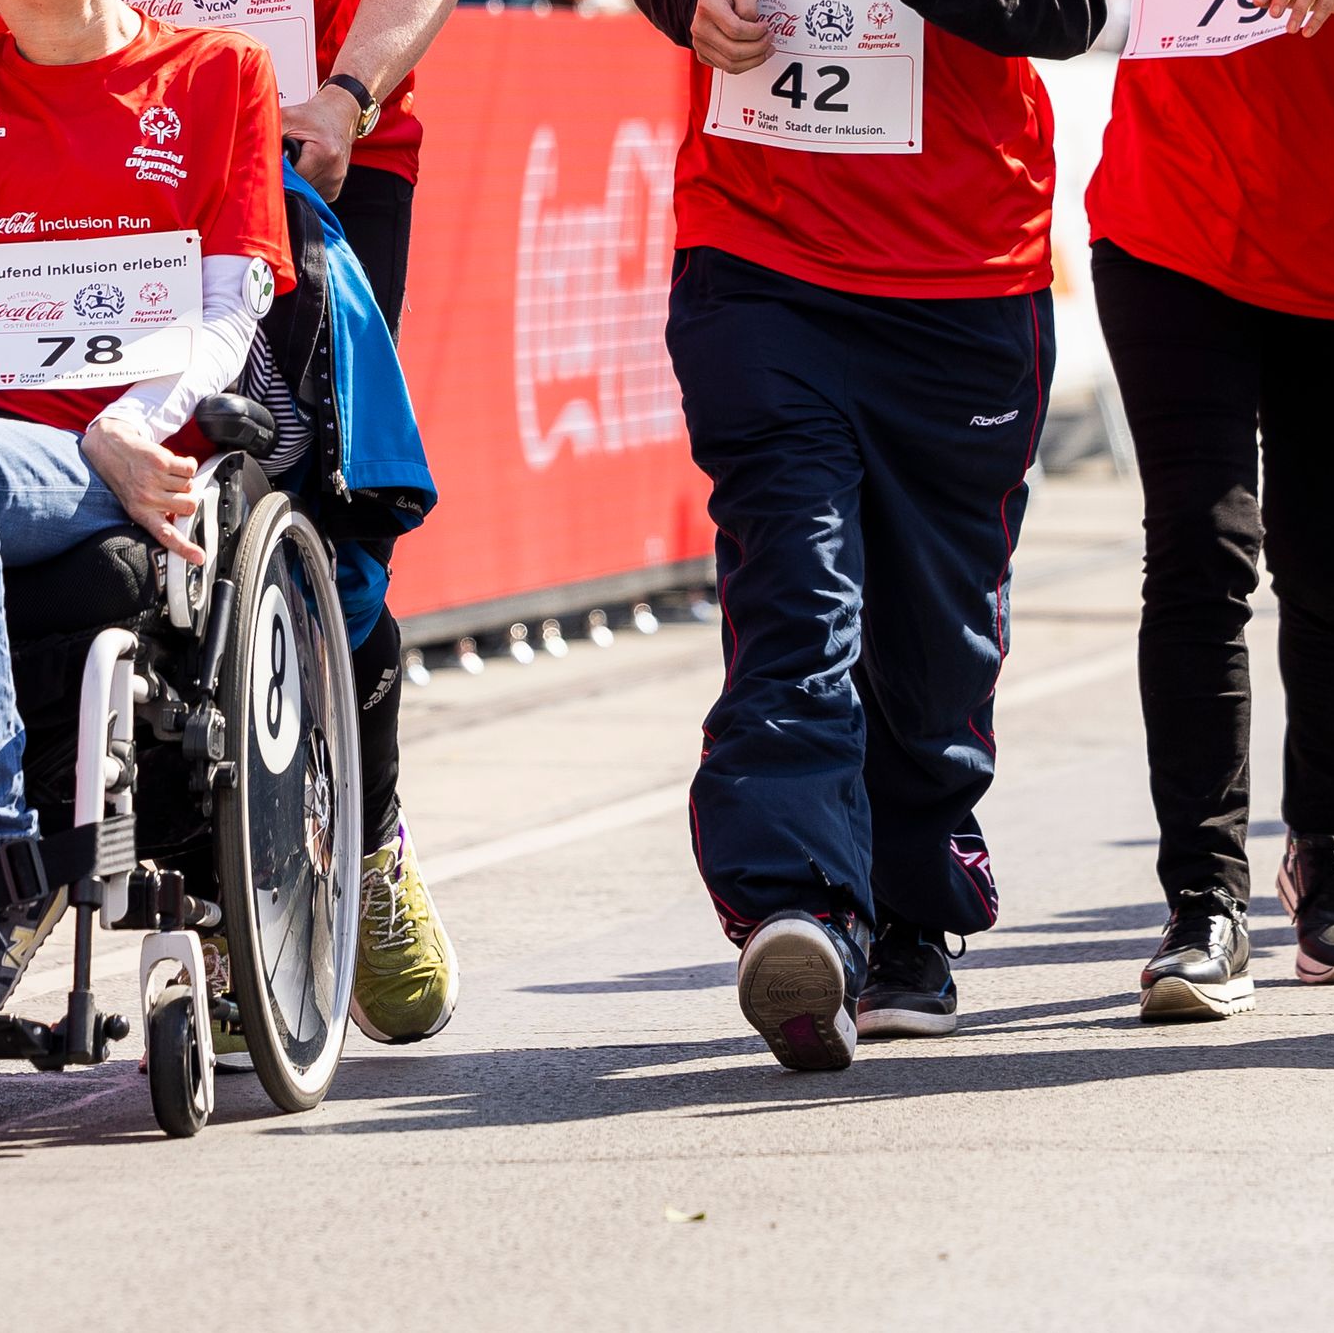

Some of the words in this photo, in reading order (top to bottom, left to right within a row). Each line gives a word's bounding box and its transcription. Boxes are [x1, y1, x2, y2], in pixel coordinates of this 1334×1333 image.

[206, 1, 231, 12] VCM
[247, 4, 292, 15] Olympics
[818, 33, 843, 42] VCM
[863, 33, 896, 41] Special
[1206, 36, 1230, 44] Stadt
[1234, 33, 1249, 41] der
[857, 42, 900, 50] Olympics
[771, 62, 850, 112] 42
[757, 120, 778, 132] Wien
[758, 110, 779, 123] Stadt
[785, 120, 811, 133] Stadt
[815, 124, 832, 134] der
[835, 124, 885, 135] Inklusion.
[132, 145, 184, 165] Special
[125, 157, 187, 179] Olympics
[136, 168, 179, 188] Österreich
[40, 217, 112, 232] Inclusion
[118, 215, 150, 229] Run
[47, 262, 117, 276] Inklusion
[123, 255, 187, 271] erleben!
[130, 316, 177, 324] Olympics
[135, 309, 172, 317] Special
[37, 335, 123, 368] 78
[267, 613, 286, 740] 8
